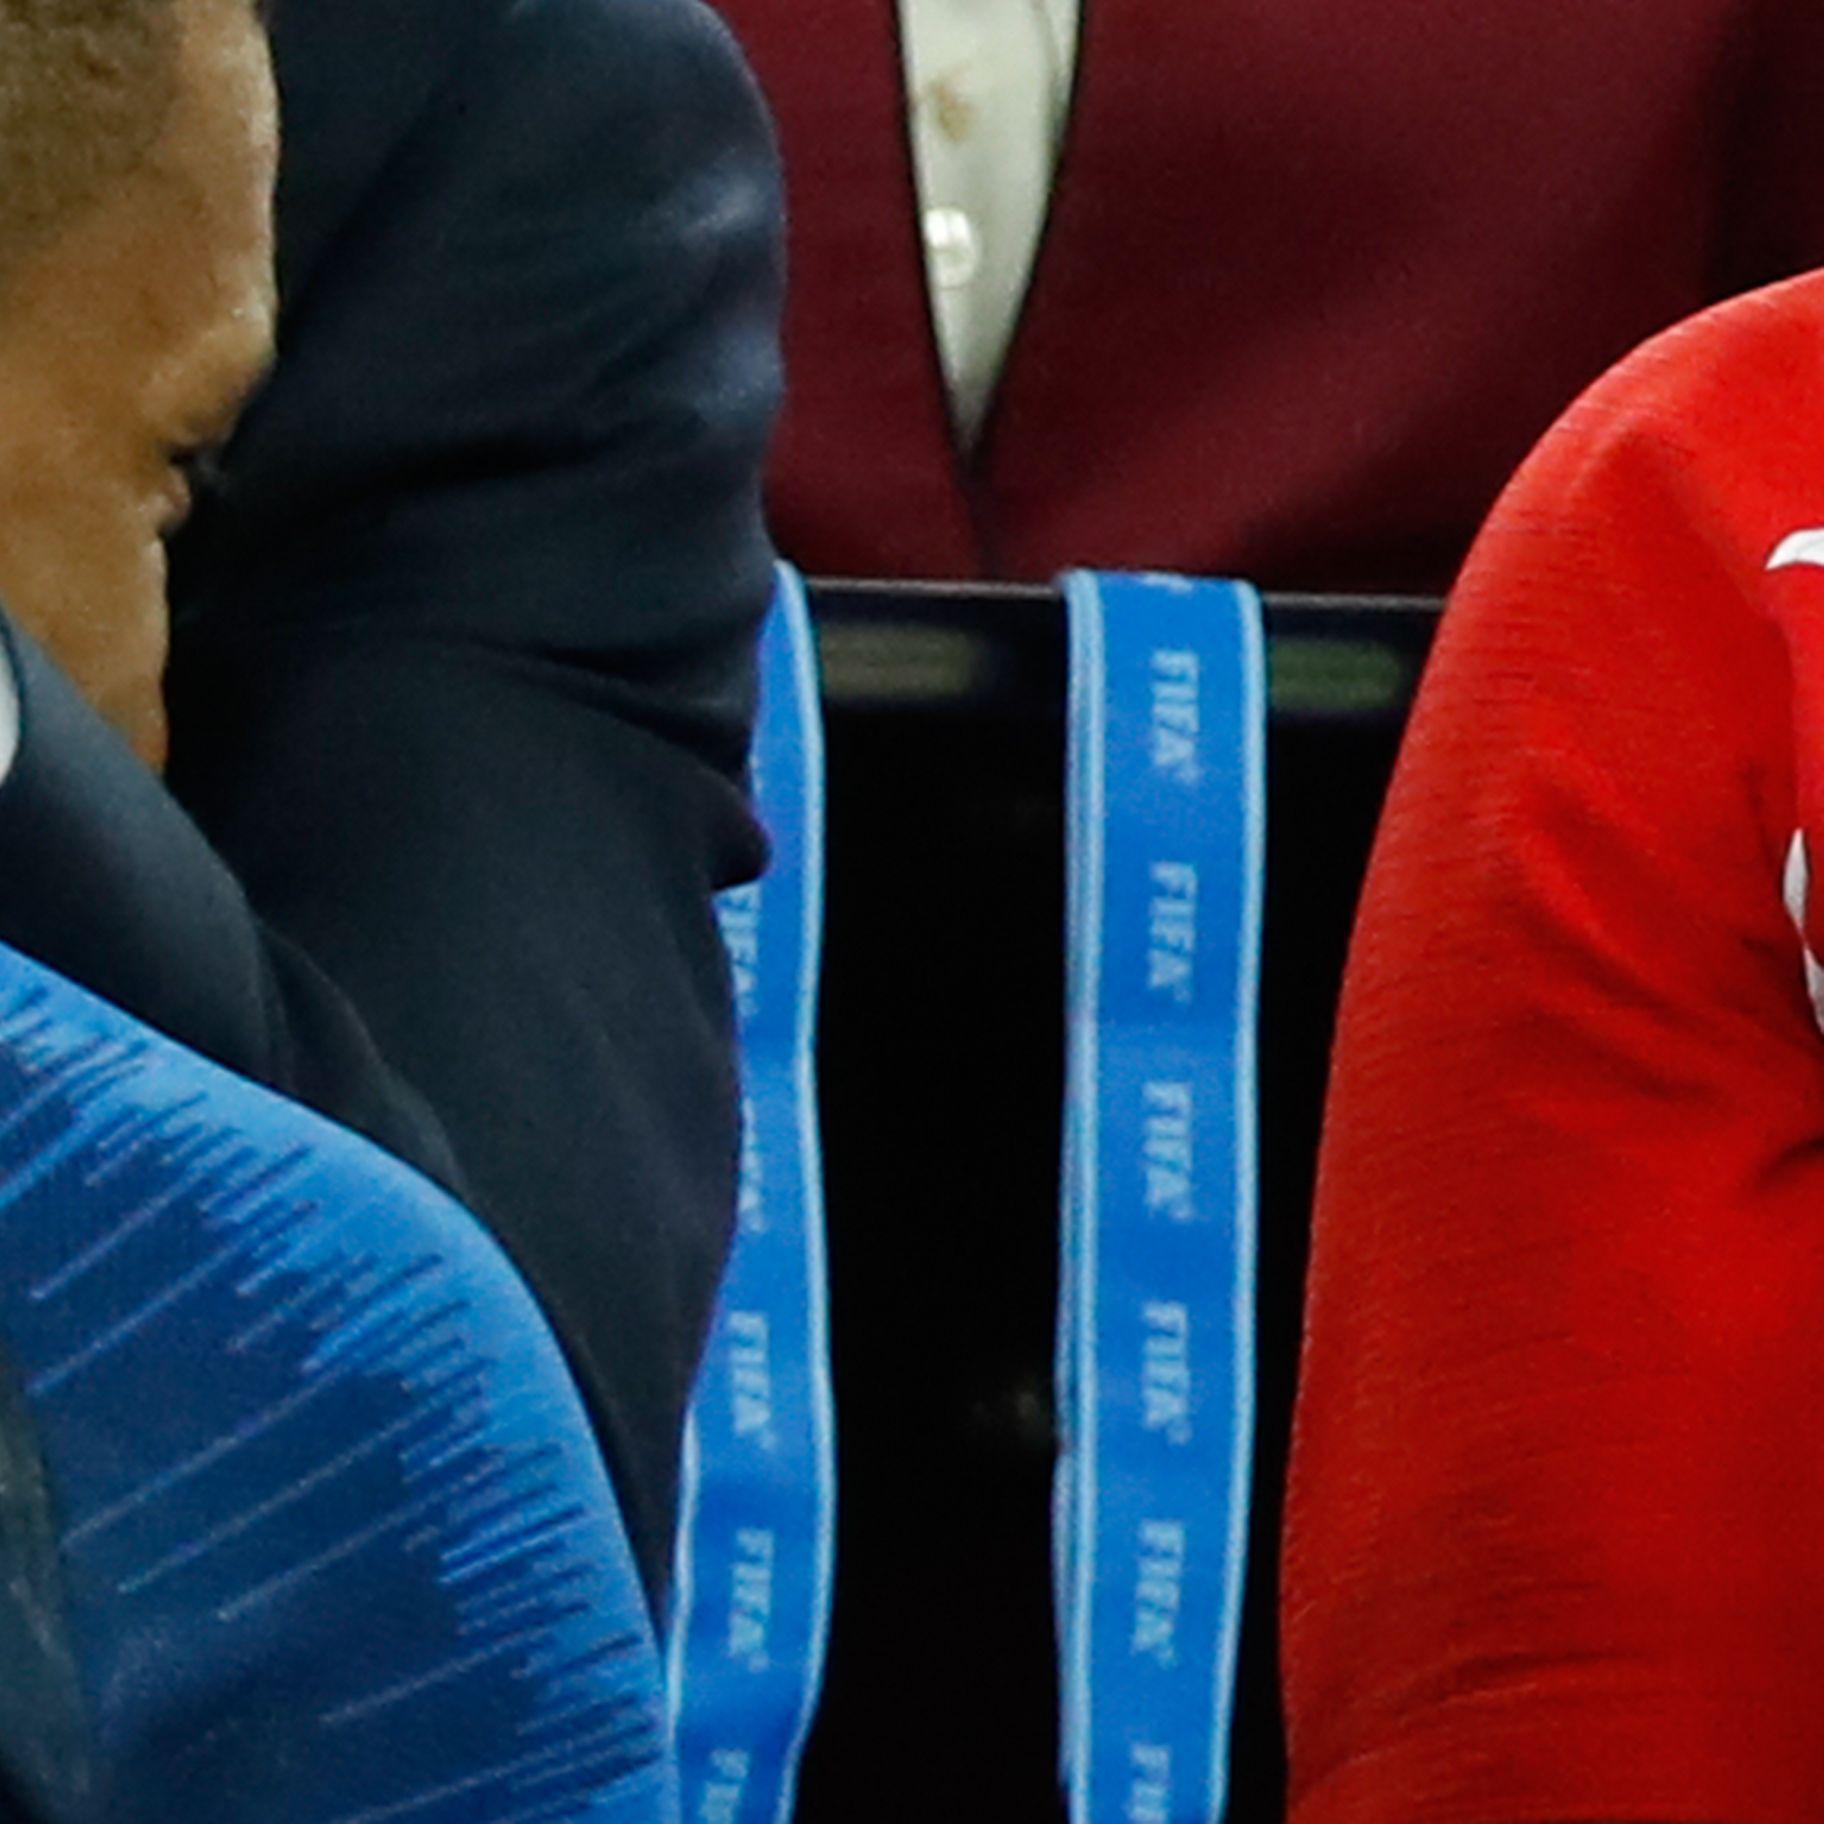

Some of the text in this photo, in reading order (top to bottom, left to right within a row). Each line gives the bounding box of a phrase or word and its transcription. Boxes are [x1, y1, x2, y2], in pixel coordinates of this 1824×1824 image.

[1150, 649, 1200, 768] FIFA
[1148, 861, 1198, 991] FIFA
[1142, 1080, 1194, 1210] FIFA
[727, 1311, 771, 1438] FIFA
[1141, 1300, 1191, 1431] FIFA
[728, 1527, 776, 1658] FIFA
[1132, 1519, 1186, 1655] FIFA
